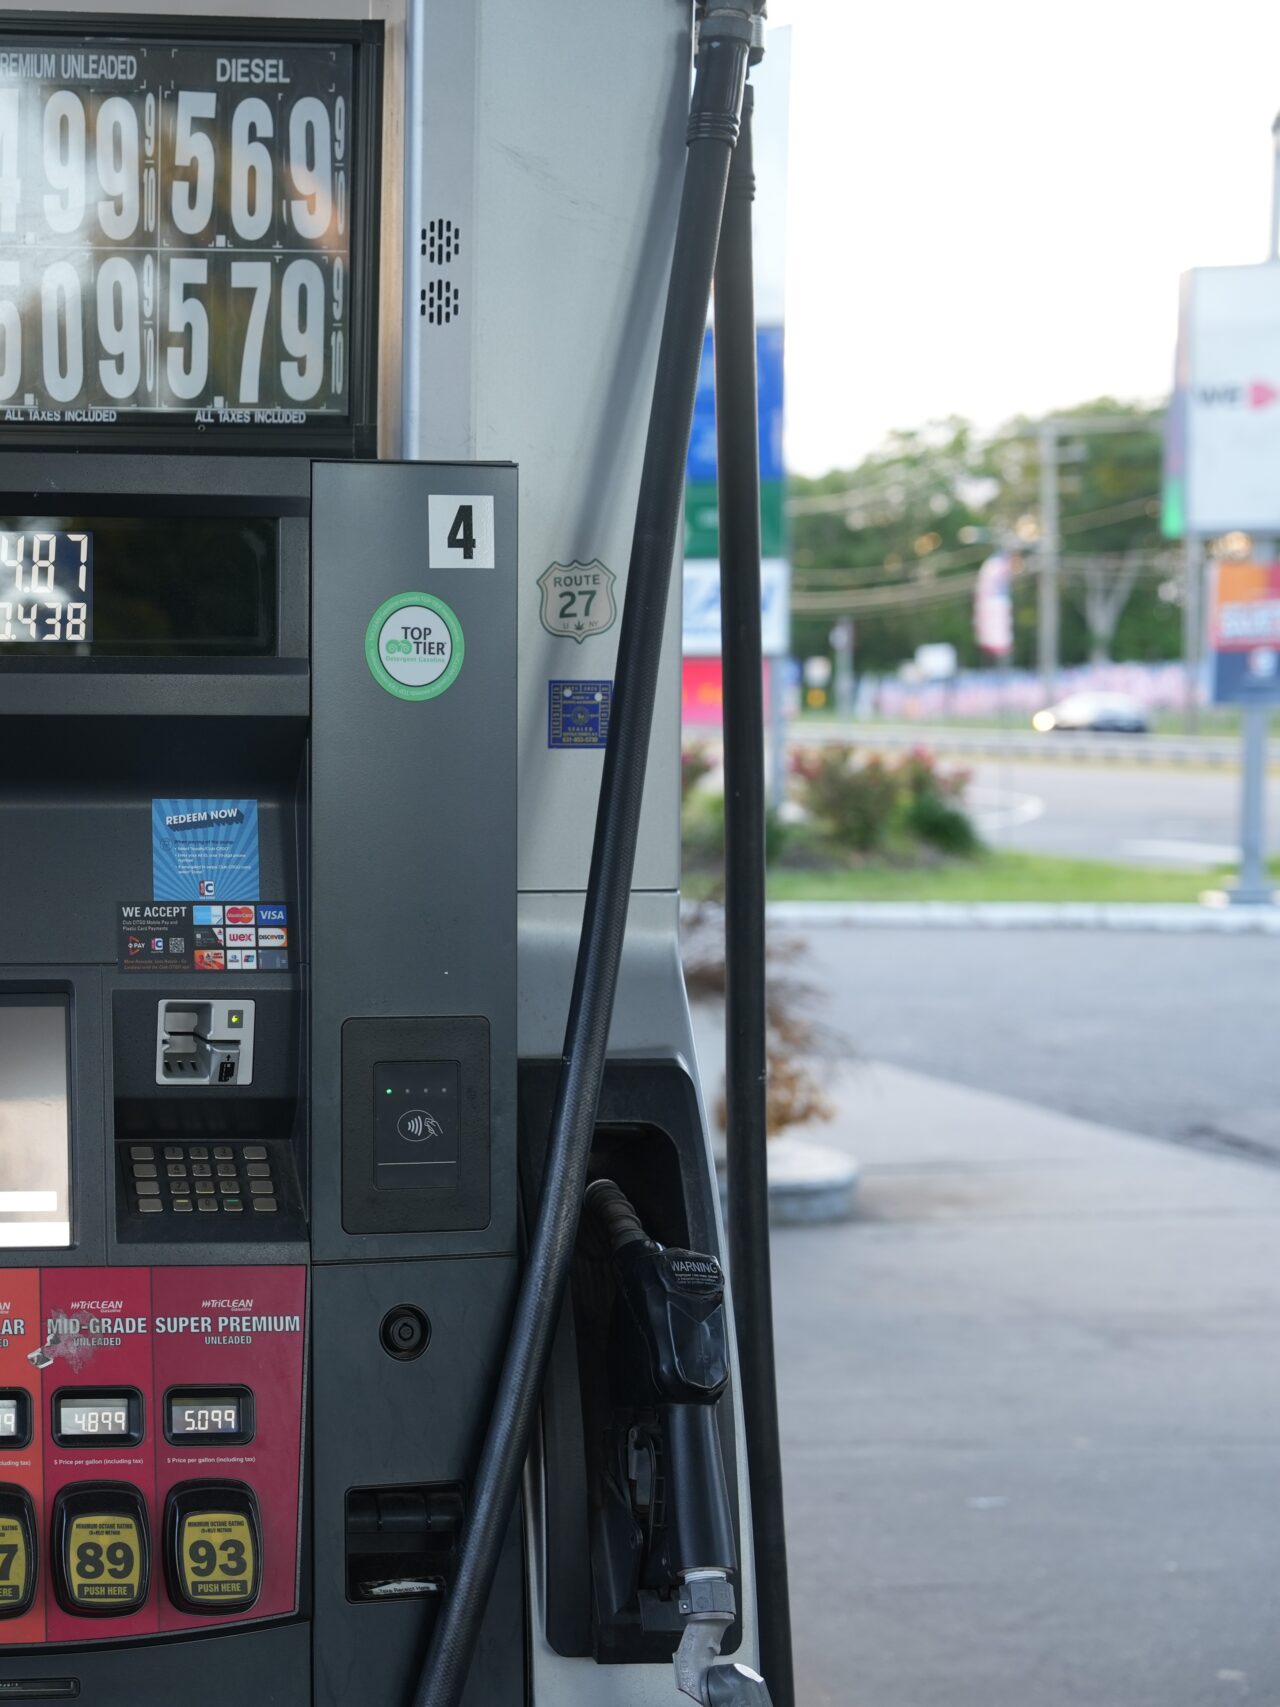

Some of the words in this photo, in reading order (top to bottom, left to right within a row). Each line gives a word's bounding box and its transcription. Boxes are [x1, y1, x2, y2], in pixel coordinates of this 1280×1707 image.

[61, 55, 137, 81] UNLEADED
[216, 58, 290, 84] DIESEL
[4, 409, 24, 421] ALL
[27, 409, 61, 421] TAXES
[64, 410, 117, 422] INCLUDED
[194, 411, 214, 423] ALL
[218, 411, 252, 423] TAXES
[254, 412, 306, 424] INCLUDED
[447, 505, 476, 560] 4
[553, 574, 600, 587] ROUTE
[559, 590, 596, 618] 27
[401, 627, 432, 640] TOP
[413, 641, 445, 655] TIER
[165, 812, 207, 825] REDEEM
[211, 808, 238, 820] NOW
[122, 907, 141, 917] WE
[144, 906, 187, 917] ACCEPT
[260, 911, 284, 920] VISA
[670, 1260, 718, 1274] WARNING
[47, 1317, 147, 1334] MID-GRADE
[155, 1317, 212, 1333] SUPER
[218, 1316, 300, 1333] PREMIUM
[73, 1337, 121, 1346] UNLEADED
[204, 1336, 252, 1345] UNLEADED
[74, 1412, 126, 1432] 4.899
[184, 1410, 235, 1431] 5.099
[75, 1541, 135, 1580] 89
[188, 1539, 247, 1577] 93
[83, 1585, 106, 1595] PUSH
[108, 1585, 127, 1595] HERE
[198, 1582, 219, 1592] PUSH
[222, 1582, 242, 1592] HERE
